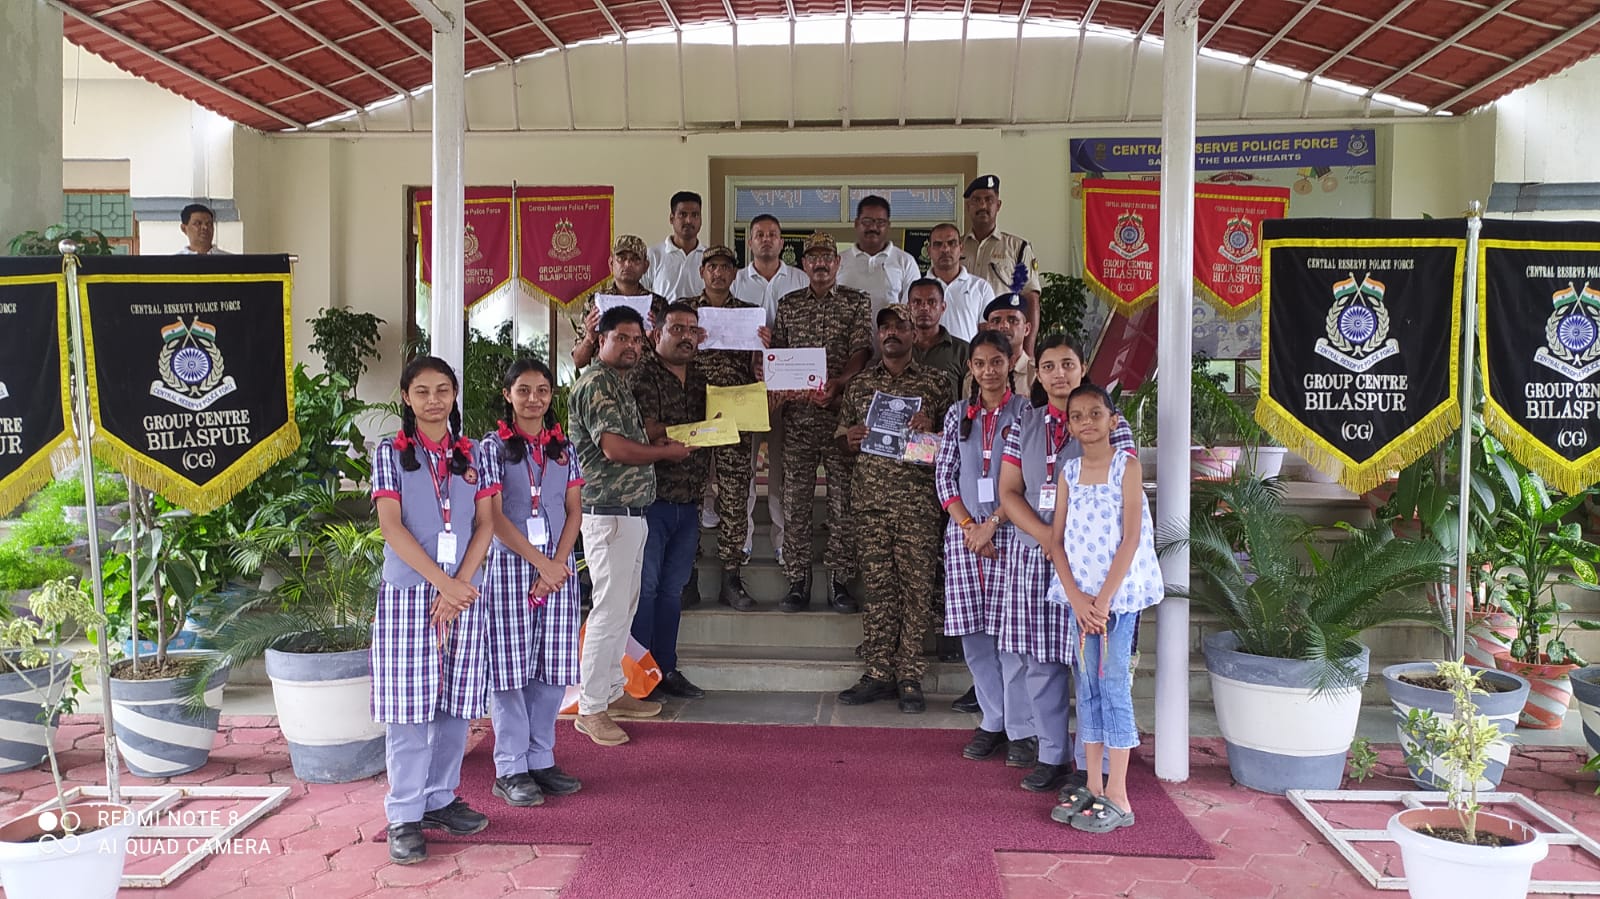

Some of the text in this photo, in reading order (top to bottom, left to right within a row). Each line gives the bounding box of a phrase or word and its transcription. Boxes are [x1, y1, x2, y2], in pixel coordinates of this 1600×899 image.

[1112, 137, 1338, 156] CENTRA SERVE POLICE FORCE
[1223, 153, 1302, 164] BRAVEHEARTS
[465, 268, 494, 276] CENTRE
[539, 265, 592, 274] GROUP CENTRE
[1307, 258, 1414, 270] CENTRAL RESERVE POLICE FORCE
[1526, 265, 1600, 278] CENTRAL RESERVE POLI
[1103, 268, 1152, 280] BILASPUR
[1212, 272, 1262, 284] BILASPUR
[0, 303, 17, 313] ORCE
[130, 300, 241, 314] CENTRAL RESERVE POLICE FORCE
[1304, 373, 1408, 391] GROUP CENTRE
[1525, 382, 1600, 399] GROUP CEN
[1304, 391, 1407, 412] BILASPUR
[1525, 400, 1600, 420] BILASP
[143, 410, 250, 431] GROUP CENTRE
[146, 426, 252, 451] BILASPUR
[1341, 420, 1374, 442] (CG)
[1557, 427, 1588, 449] (CG)
[182, 449, 216, 471] (CG)
